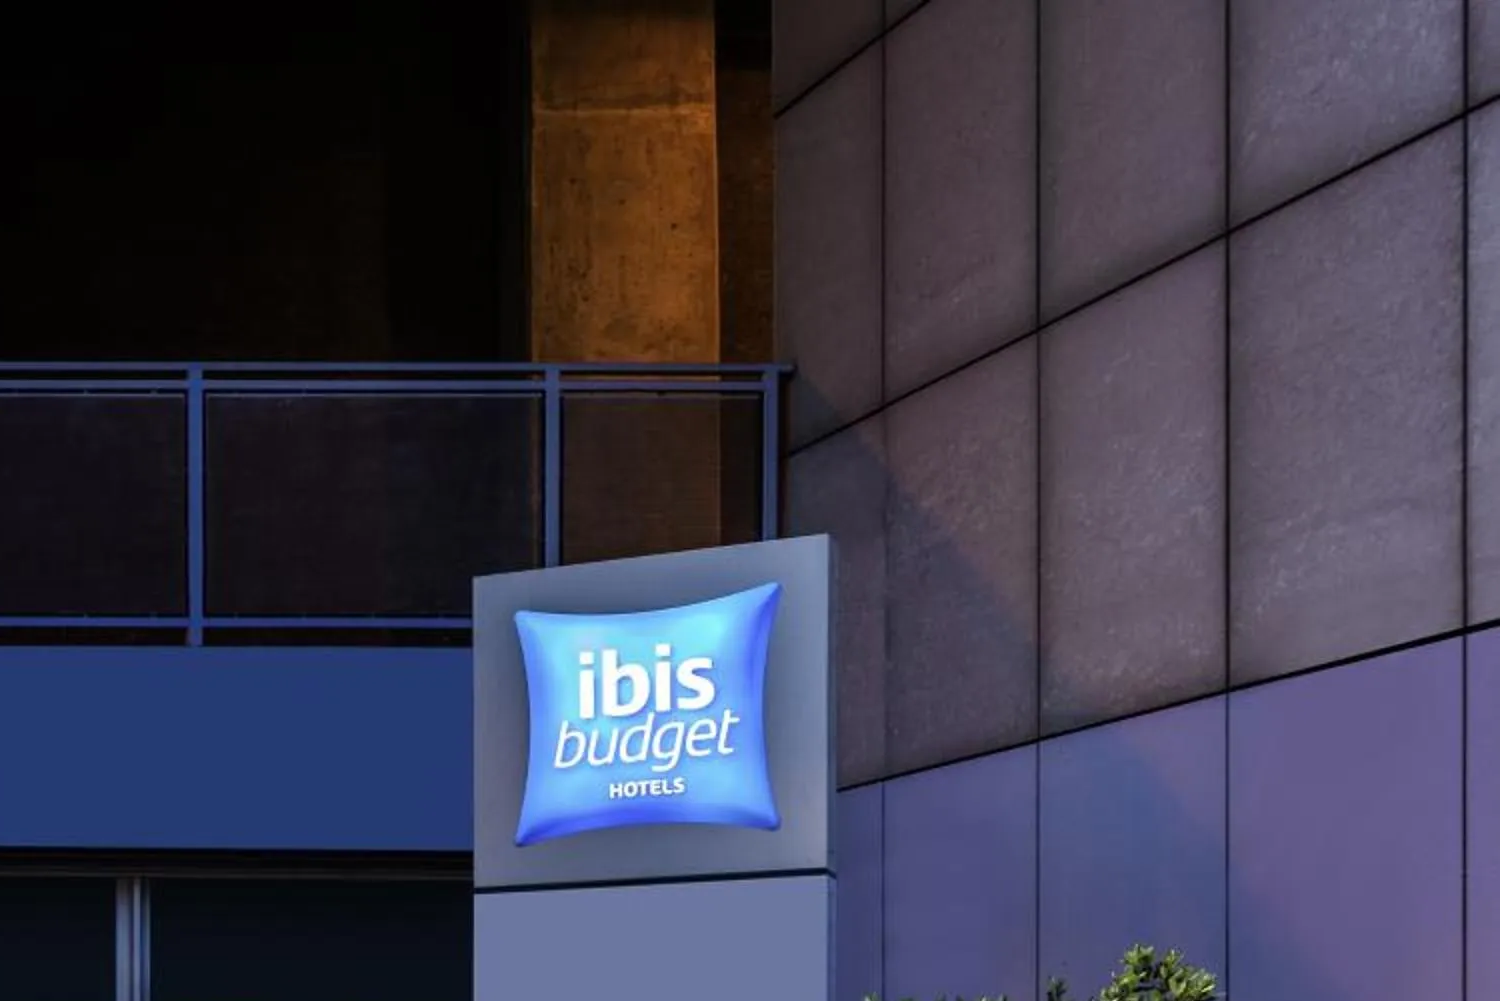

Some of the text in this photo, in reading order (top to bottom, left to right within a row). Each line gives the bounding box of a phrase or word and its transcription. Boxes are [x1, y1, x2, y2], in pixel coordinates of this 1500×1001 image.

[578, 643, 716, 720] ibis
[553, 708, 740, 773] budget
[608, 777, 686, 799] HOTELS
